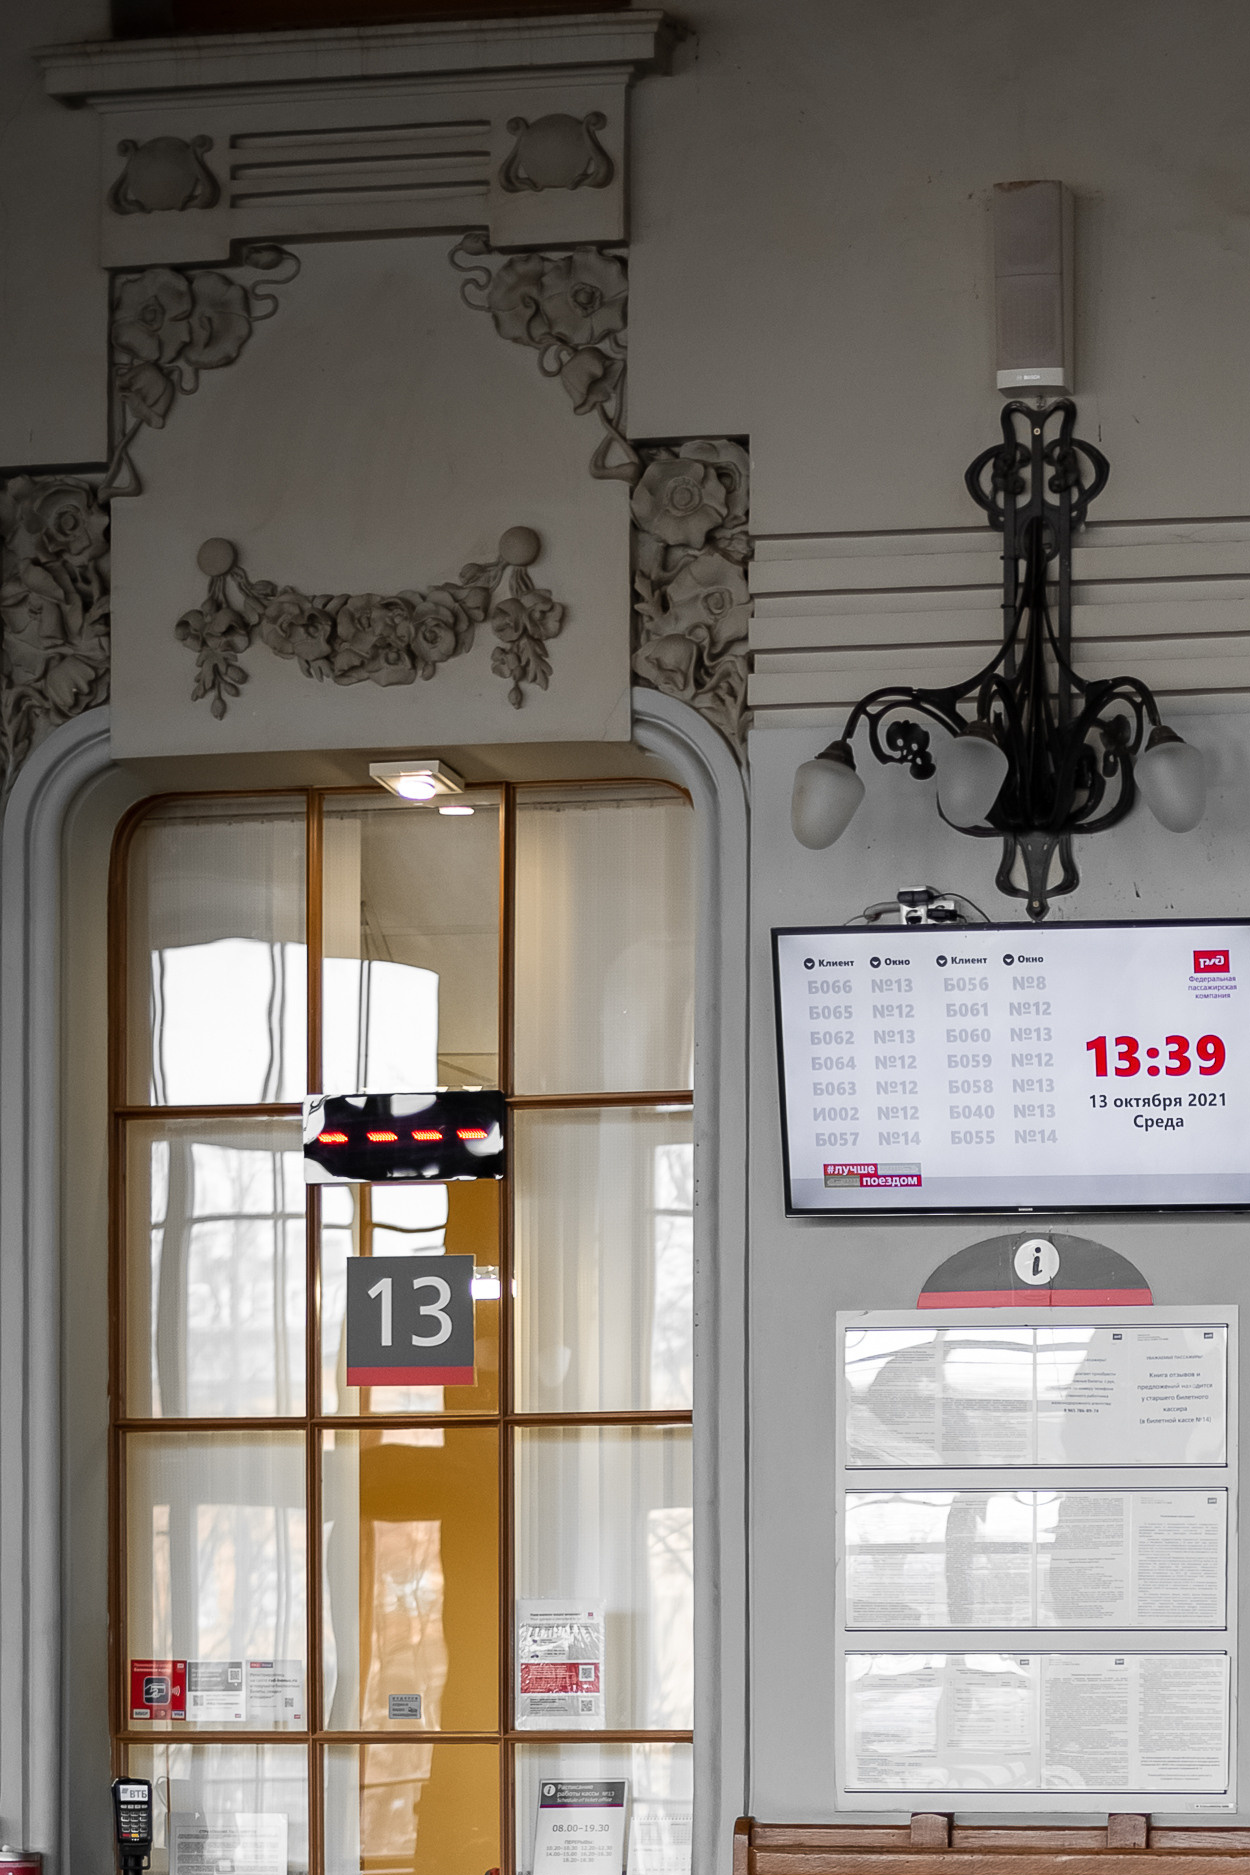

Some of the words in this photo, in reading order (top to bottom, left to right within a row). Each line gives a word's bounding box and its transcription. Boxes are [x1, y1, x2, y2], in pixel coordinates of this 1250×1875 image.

[818, 959, 854, 968] Клиент
[884, 958, 910, 966] Окно
[951, 956, 987, 965] Клиент
[1018, 955, 1044, 964] Окно
[807, 980, 853, 994] Б066
[871, 978, 914, 993] №13
[943, 977, 989, 992] Б056
[1012, 976, 1047, 991] №8
[1189, 975, 1236, 983] Федеральная
[809, 1005, 854, 1020] Б065
[872, 1004, 915, 1019] №12
[946, 1002, 989, 1017] Б061
[1009, 1001, 1052, 1016] №12
[810, 1031, 855, 1046] Б062
[873, 1029, 916, 1044] №13
[946, 1028, 991, 1043] Б060
[1010, 1027, 1053, 1042] №13
[811, 1056, 857, 1071] Б064
[875, 1055, 917, 1070] №12
[947, 1054, 992, 1069] Б059
[1011, 1052, 1054, 1067] №12
[1086, 1034, 1226, 1077] 13:39
[813, 1081, 857, 1096] Б063
[876, 1081, 919, 1095] №12
[948, 1079, 994, 1094] Б058
[1012, 1078, 1055, 1093] №13
[1089, 1094, 1108, 1108] 13
[1114, 1094, 1182, 1111] октября
[1188, 1093, 1226, 1107] 2021
[813, 1107, 859, 1122] И002
[877, 1106, 920, 1121] №12
[949, 1105, 995, 1119] Б040
[1013, 1104, 1056, 1119] №13
[1133, 1115, 1184, 1131] Среда
[815, 1132, 859, 1147] Б057
[878, 1131, 921, 1146] №14
[950, 1130, 996, 1145] Б055
[1014, 1129, 1058, 1144] №14
[827, 1164, 875, 1176] #лучше
[862, 1176, 918, 1187] поездом
[367, 1276, 453, 1347] 13
[1137, 1383, 1180, 1391] предложений
